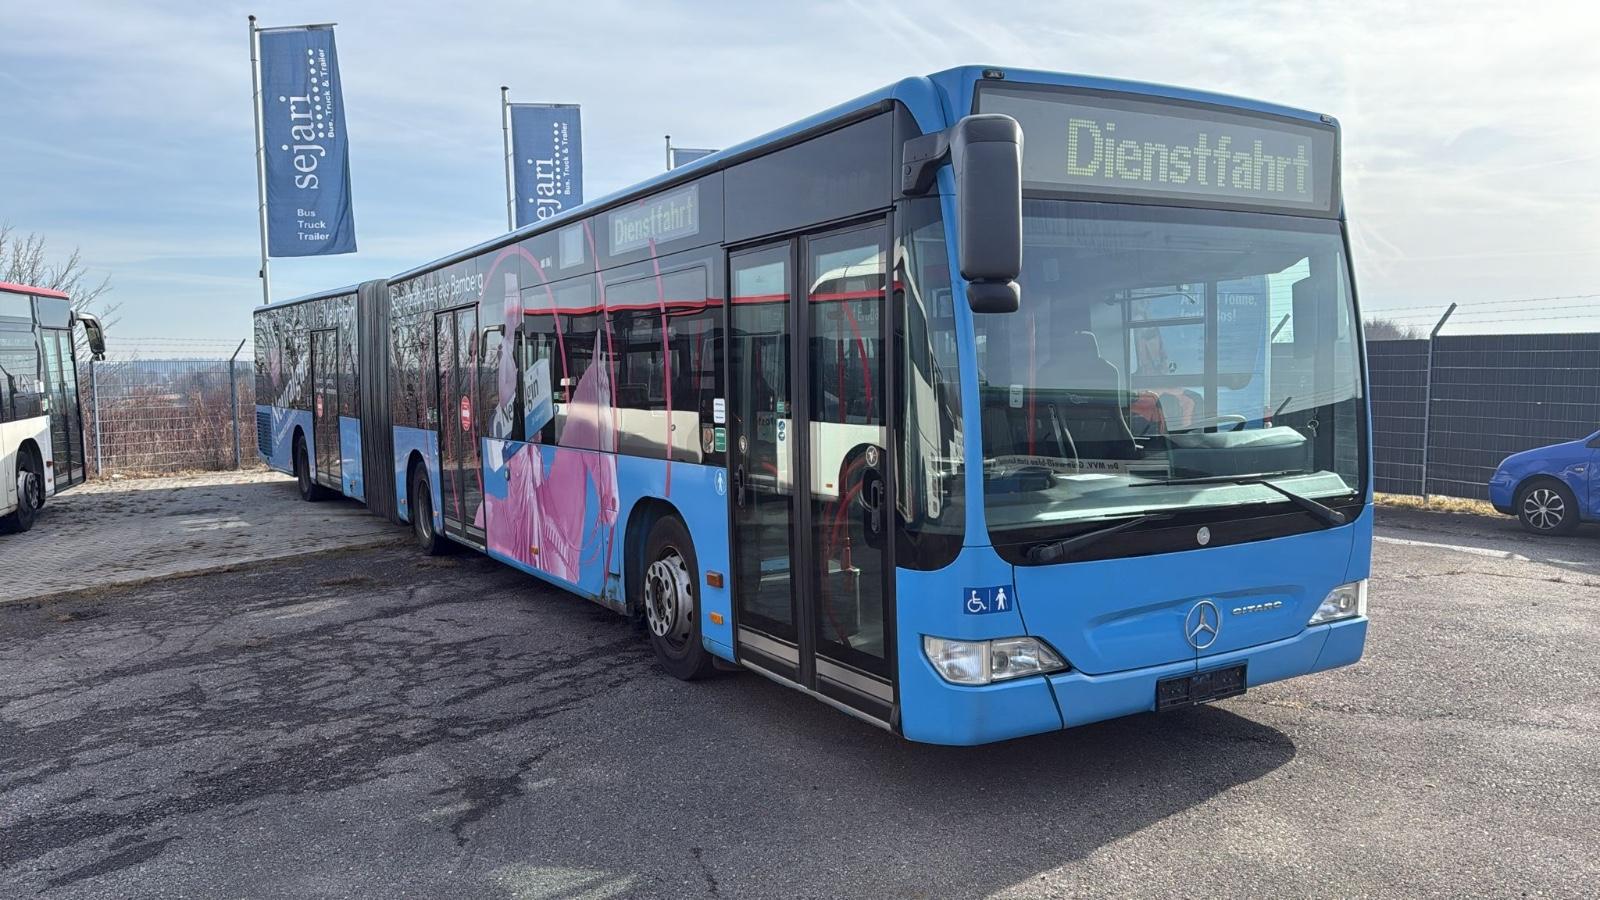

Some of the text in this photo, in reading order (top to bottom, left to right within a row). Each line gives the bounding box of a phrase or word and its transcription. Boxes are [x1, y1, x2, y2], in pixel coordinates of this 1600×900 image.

[318, 48, 328, 77] Trailer
[323, 90, 332, 116] Truck
[279, 93, 326, 189] sejari
[562, 156, 570, 177] Truck
[1066, 118, 1309, 194] Dienstfahrt
[527, 158, 562, 220] ejari
[296, 208, 316, 217] Bus
[296, 220, 327, 229] Truck
[614, 195, 695, 246] Dienstfahrt
[297, 232, 330, 241] Trailer
[450, 269, 484, 296] Bamberg
[1232, 600, 1283, 615] CITARO
